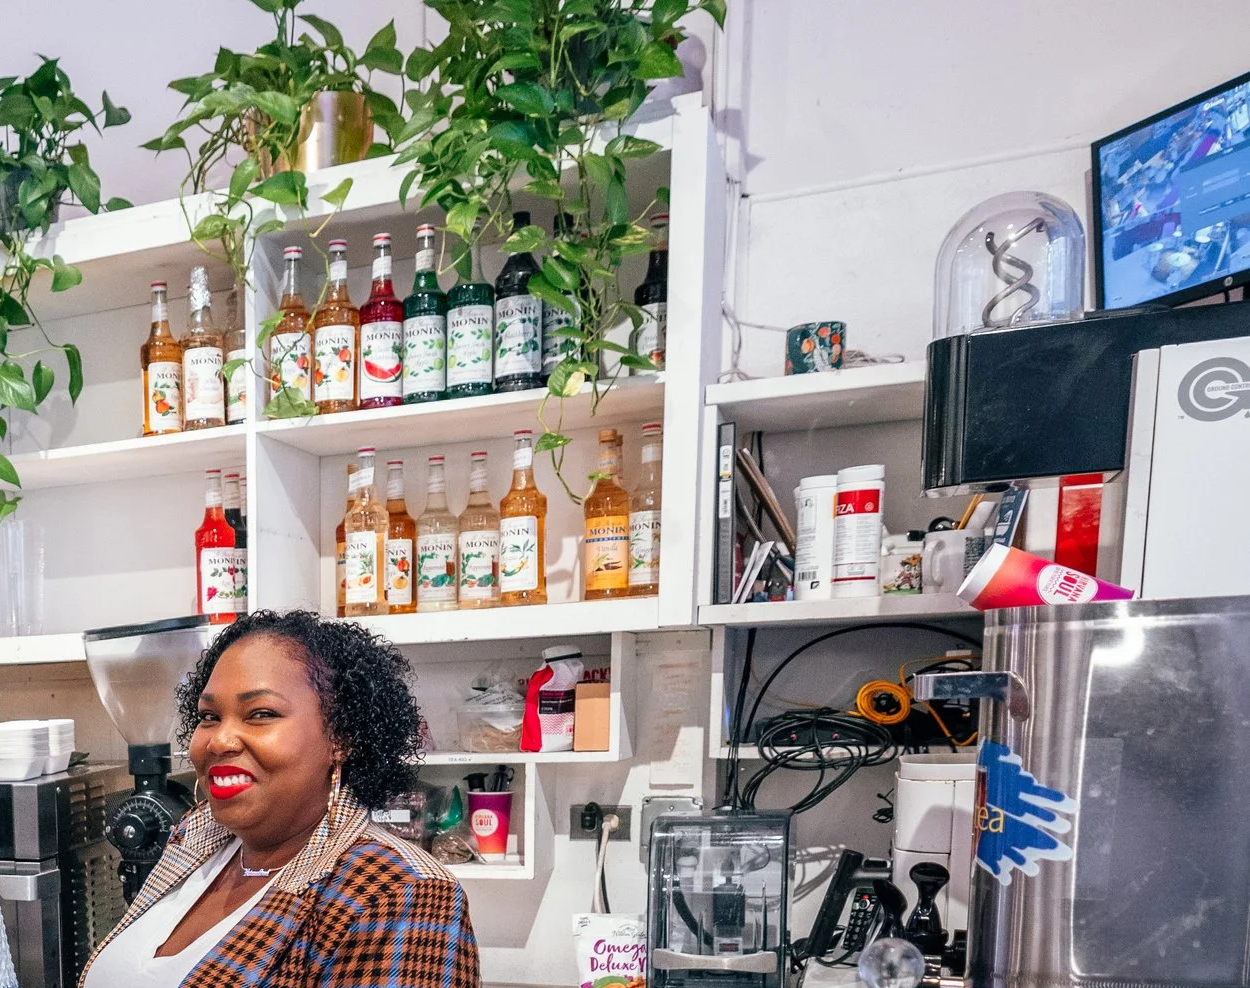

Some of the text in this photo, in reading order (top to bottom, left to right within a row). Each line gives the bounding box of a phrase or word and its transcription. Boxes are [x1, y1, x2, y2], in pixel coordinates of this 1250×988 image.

[499, 306, 537, 319] MONIN
[451, 316, 489, 328] MONIN
[367, 331, 402, 341] MONIN
[405, 326, 442, 339] MONIN
[317, 337, 349, 347] MONIN
[191, 358, 222, 366] MONIN
[157, 372, 179, 380] MON
[589, 526, 626, 536] MONIN
[421, 544, 453, 552] MONIN
[466, 540, 499, 548] MONIN
[1053, 571, 1080, 598] SOUL
[1067, 576, 1089, 603] NIRVANA
[475, 818, 493, 827] SOUL
[594, 939, 646, 961] Omega
[590, 953, 637, 972] Deluxe
